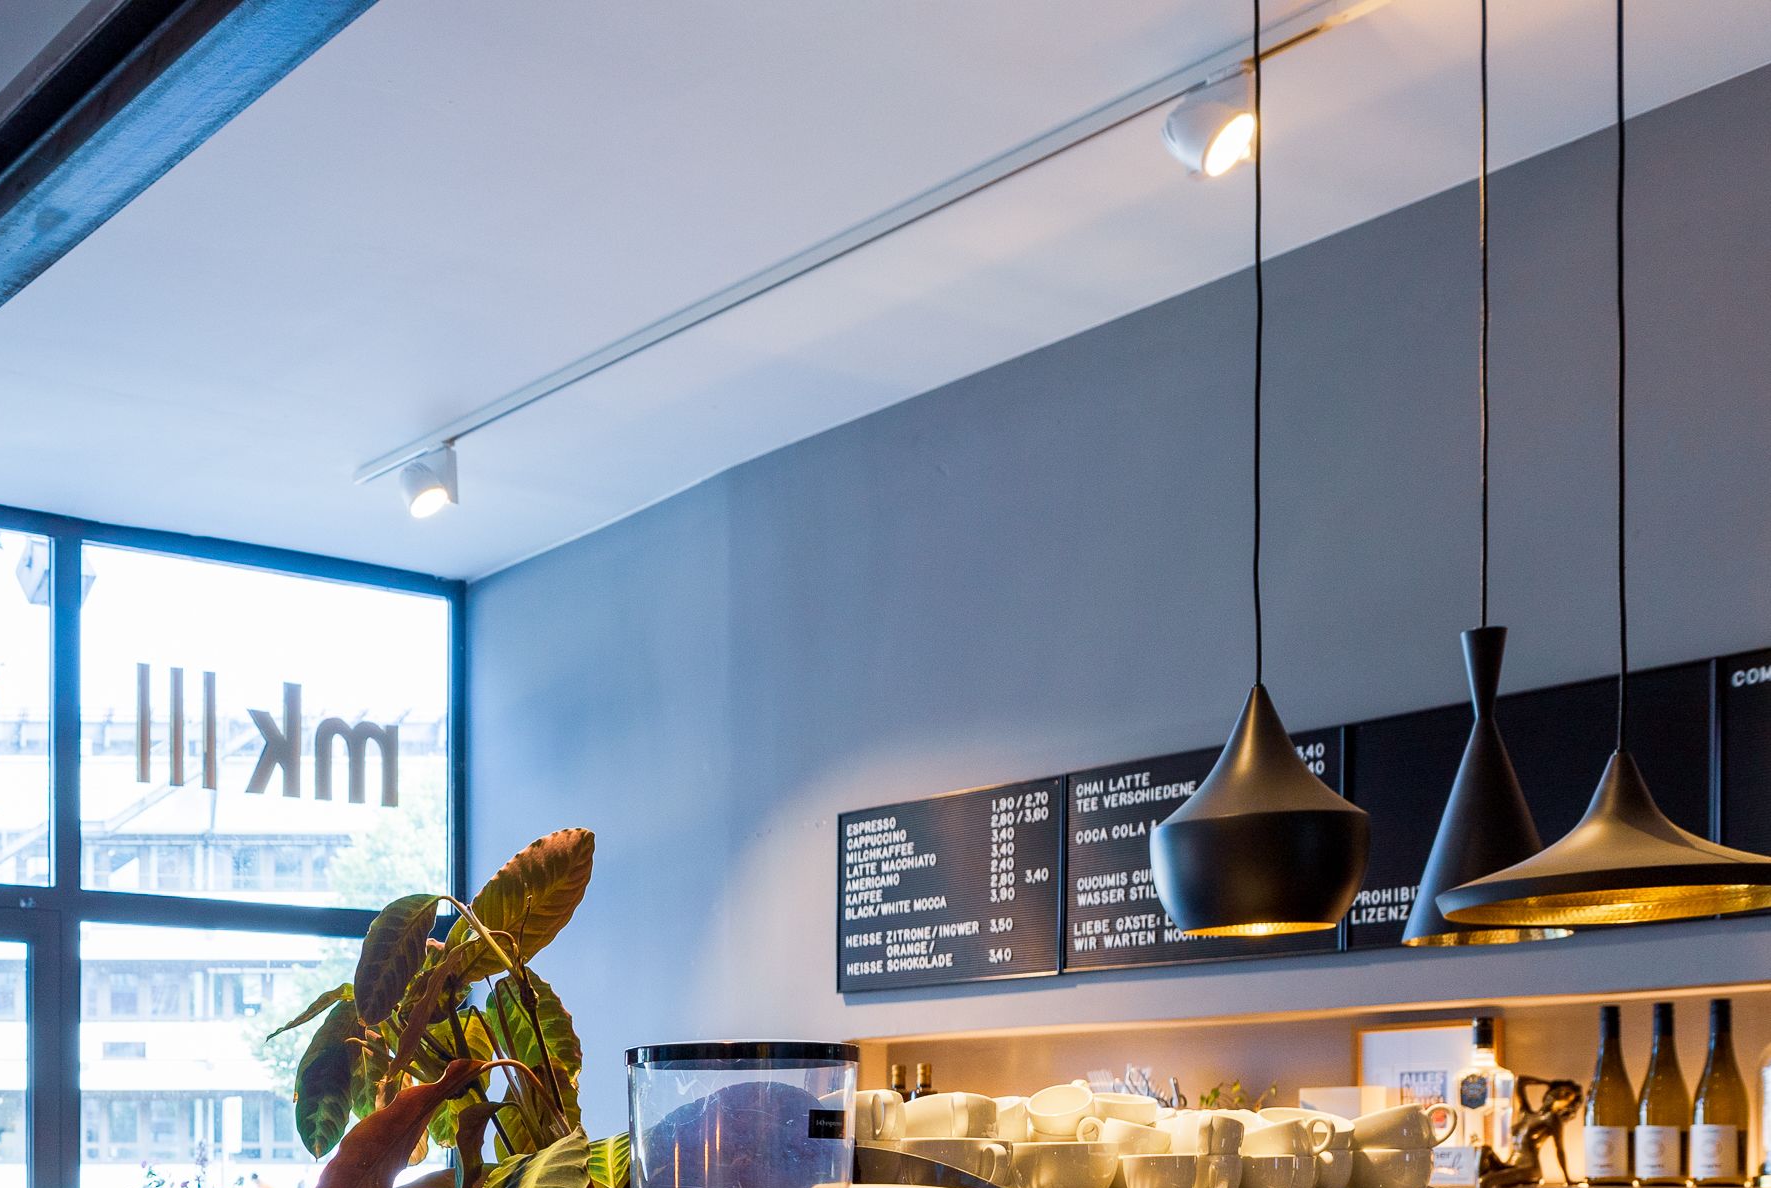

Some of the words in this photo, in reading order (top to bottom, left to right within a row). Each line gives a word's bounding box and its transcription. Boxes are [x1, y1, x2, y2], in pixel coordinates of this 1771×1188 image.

[1075, 780, 1104, 798] CHAI
[1109, 772, 1151, 792] LATTE
[1077, 797, 1099, 813] TEE
[1103, 780, 1197, 809] VERSCHIEDENE
[846, 816, 896, 837] ESPRESSO
[1076, 827, 1108, 845] COCA
[1112, 821, 1146, 840] COLA
[846, 829, 907, 850] CAPPUCCINO
[845, 842, 915, 864] MILCHKAFFEE
[846, 861, 877, 879] LATTE
[881, 853, 937, 873] MACCHIATO
[845, 873, 900, 892] AMERICANO
[1076, 871, 1128, 891] CUCUMIS
[845, 889, 883, 907] KAFFEE
[1077, 888, 1125, 907] WASSER
[845, 900, 911, 921] BLACK/WHITE
[913, 896, 947, 912] MOCCA
[1351, 904, 1409, 925] LIZENZ
[1073, 918, 1110, 937] LIEBE
[845, 932, 883, 948] HEISSE
[1074, 938, 1097, 952] WIR
[1103, 930, 1156, 949] WARTEN
[846, 960, 884, 976] HEISSE
[887, 953, 953, 973] SCHOKOLADE
